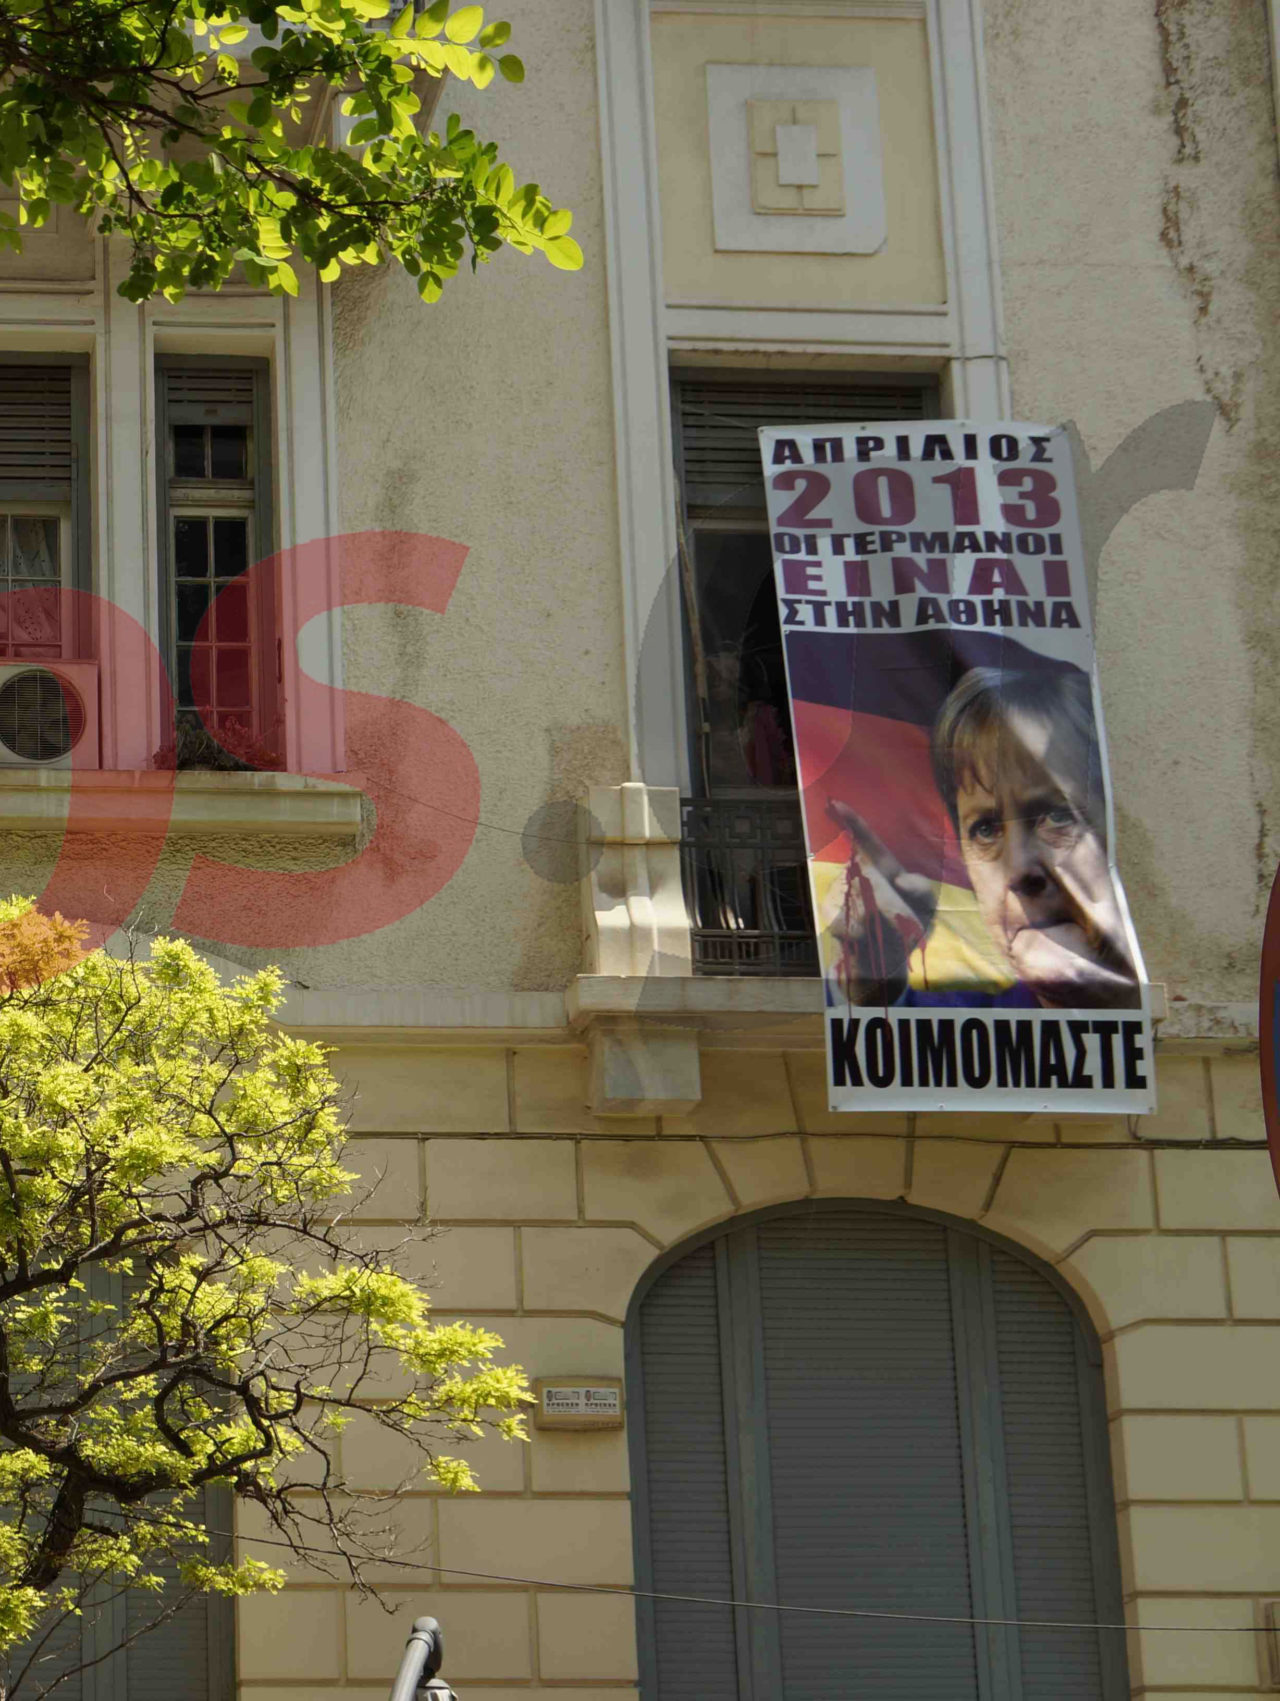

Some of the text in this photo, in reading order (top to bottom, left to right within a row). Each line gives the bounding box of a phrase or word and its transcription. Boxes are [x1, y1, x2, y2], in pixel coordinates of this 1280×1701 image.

[772, 434, 1054, 465] ΑΠΡΙΛΙΟΣ
[772, 467, 1061, 529] 2013
[774, 531, 1064, 556] ΟΙ ΓΕΡΜΑΝΟΙ
[781, 557, 1072, 597] ΕΙΝΑΙ
[780, 597, 1082, 629] ΣΤΗΝ ΑΘΗΝΑ
[830, 1016, 1148, 1090] ΚΟΙΜΟΜΑΣΤΕ
